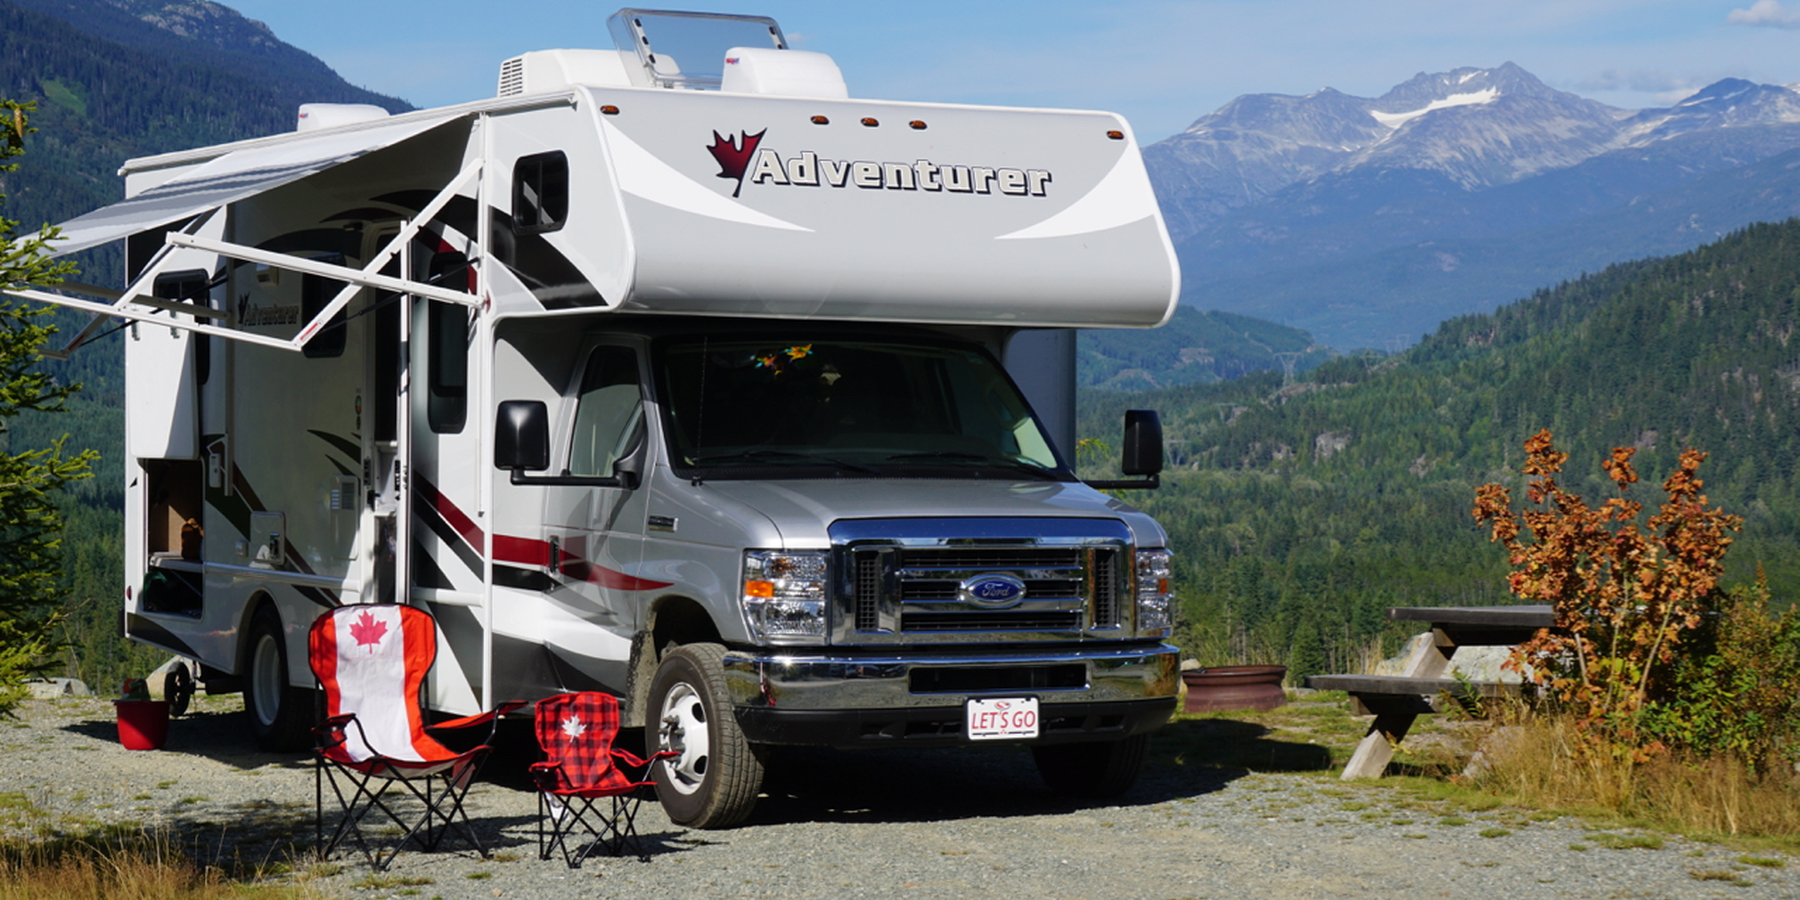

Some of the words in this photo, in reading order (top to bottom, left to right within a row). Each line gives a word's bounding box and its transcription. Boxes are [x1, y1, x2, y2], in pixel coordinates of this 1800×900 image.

[751, 148, 1051, 197] Adventurer
[982, 582, 1011, 597] Ford
[971, 711, 1009, 729] LET'S
[1012, 710, 1036, 728] GO
